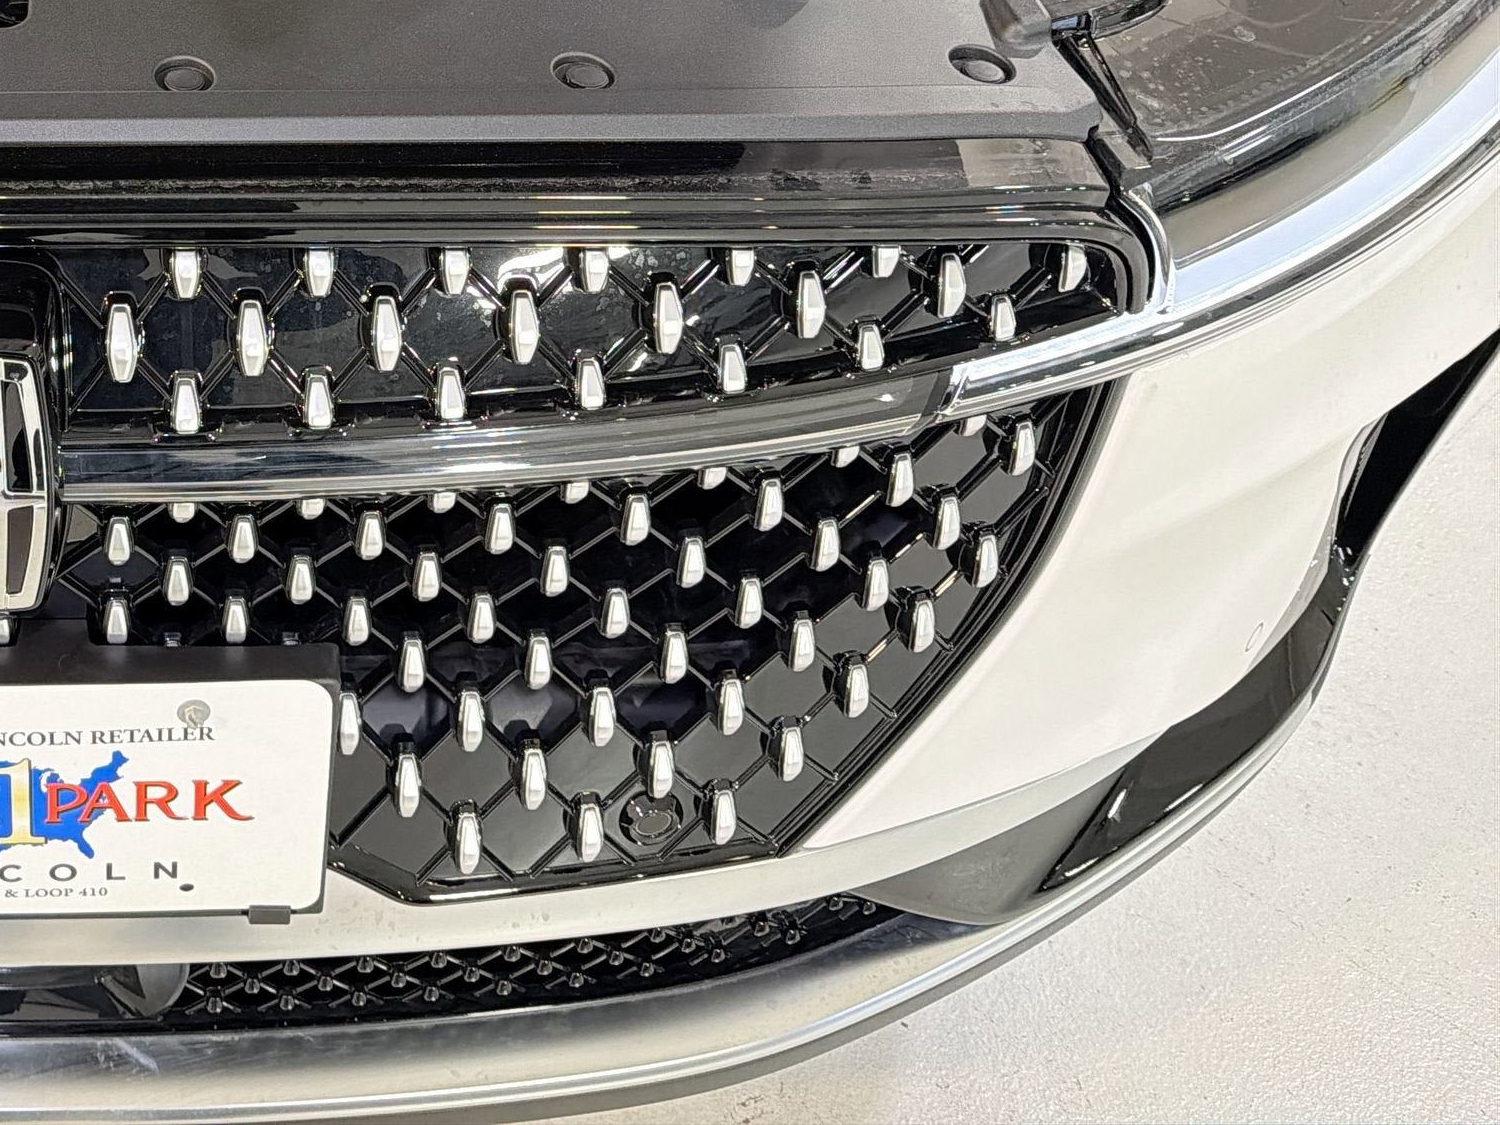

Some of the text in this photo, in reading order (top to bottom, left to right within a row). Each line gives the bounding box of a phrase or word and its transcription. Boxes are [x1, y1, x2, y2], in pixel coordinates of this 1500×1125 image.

[91, 725, 215, 745] RETAILER
[44, 779, 255, 825] PARK
[4, 889, 19, 898] &
[25, 887, 74, 898] LOOP
[78, 887, 108, 897] 410
